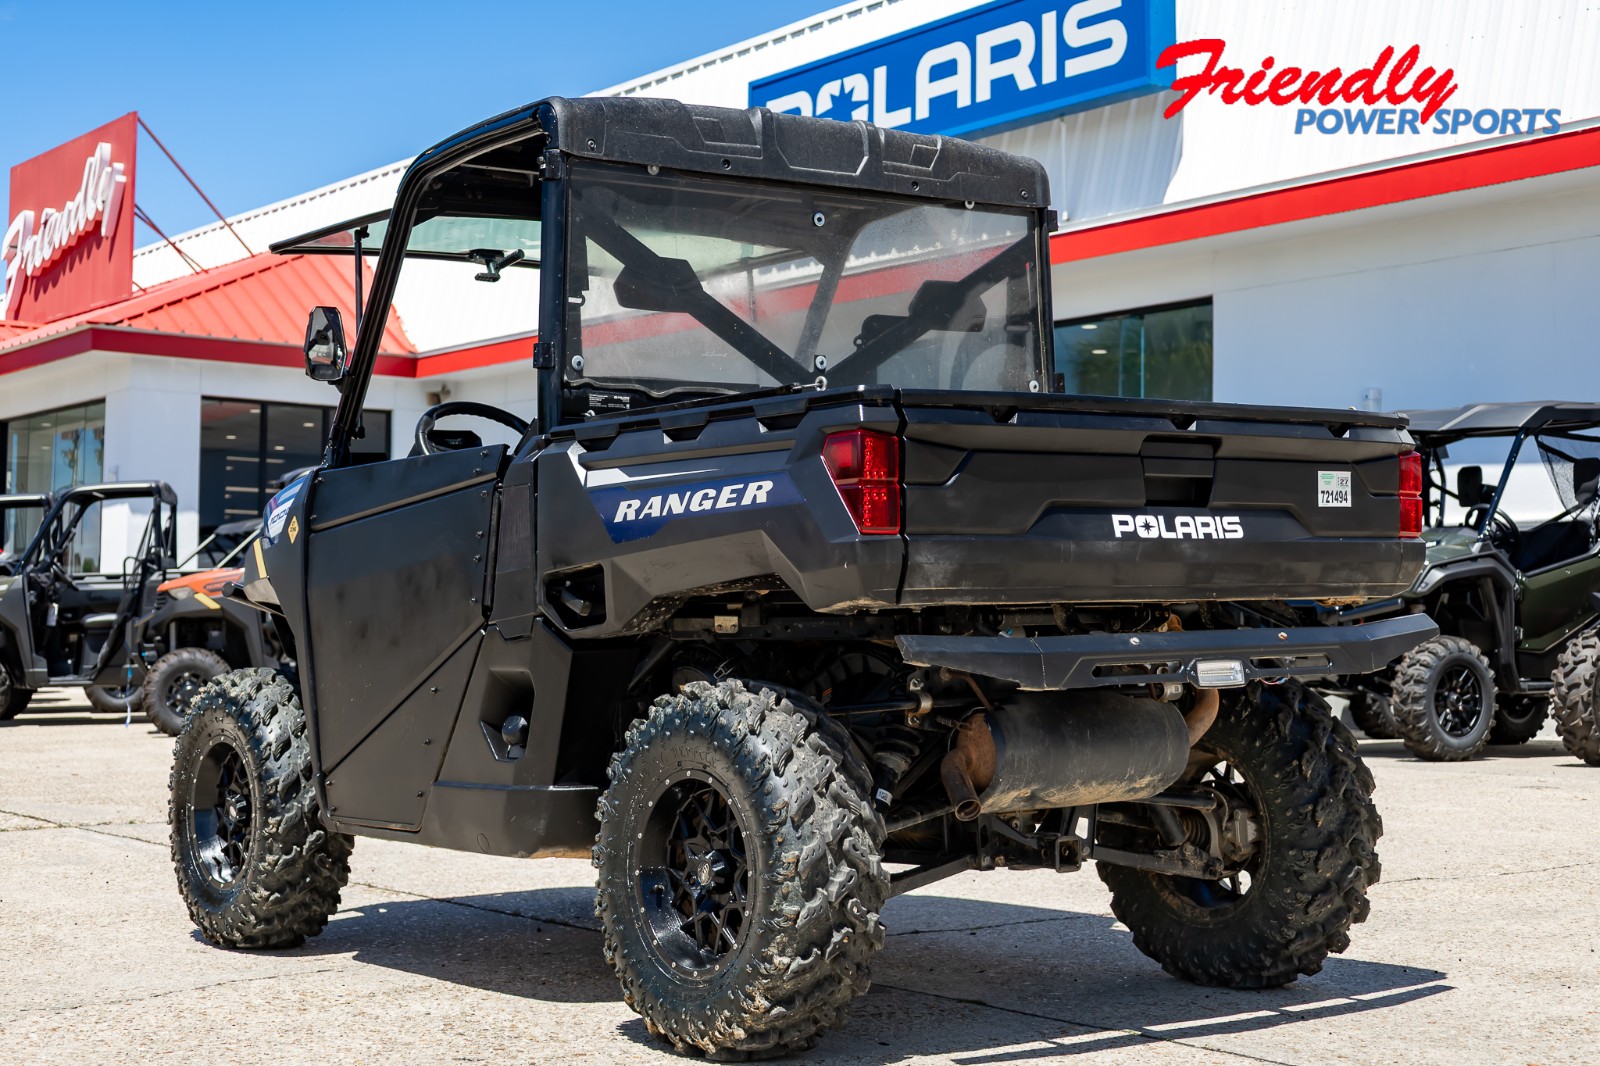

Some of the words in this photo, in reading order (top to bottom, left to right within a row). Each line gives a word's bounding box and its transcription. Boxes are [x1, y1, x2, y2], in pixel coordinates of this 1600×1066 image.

[1, 142, 127, 312] Friendly
[613, 479, 775, 524] RANGER
[1320, 490, 1348, 504] 721494
[1111, 514, 1244, 540] POLARIS
